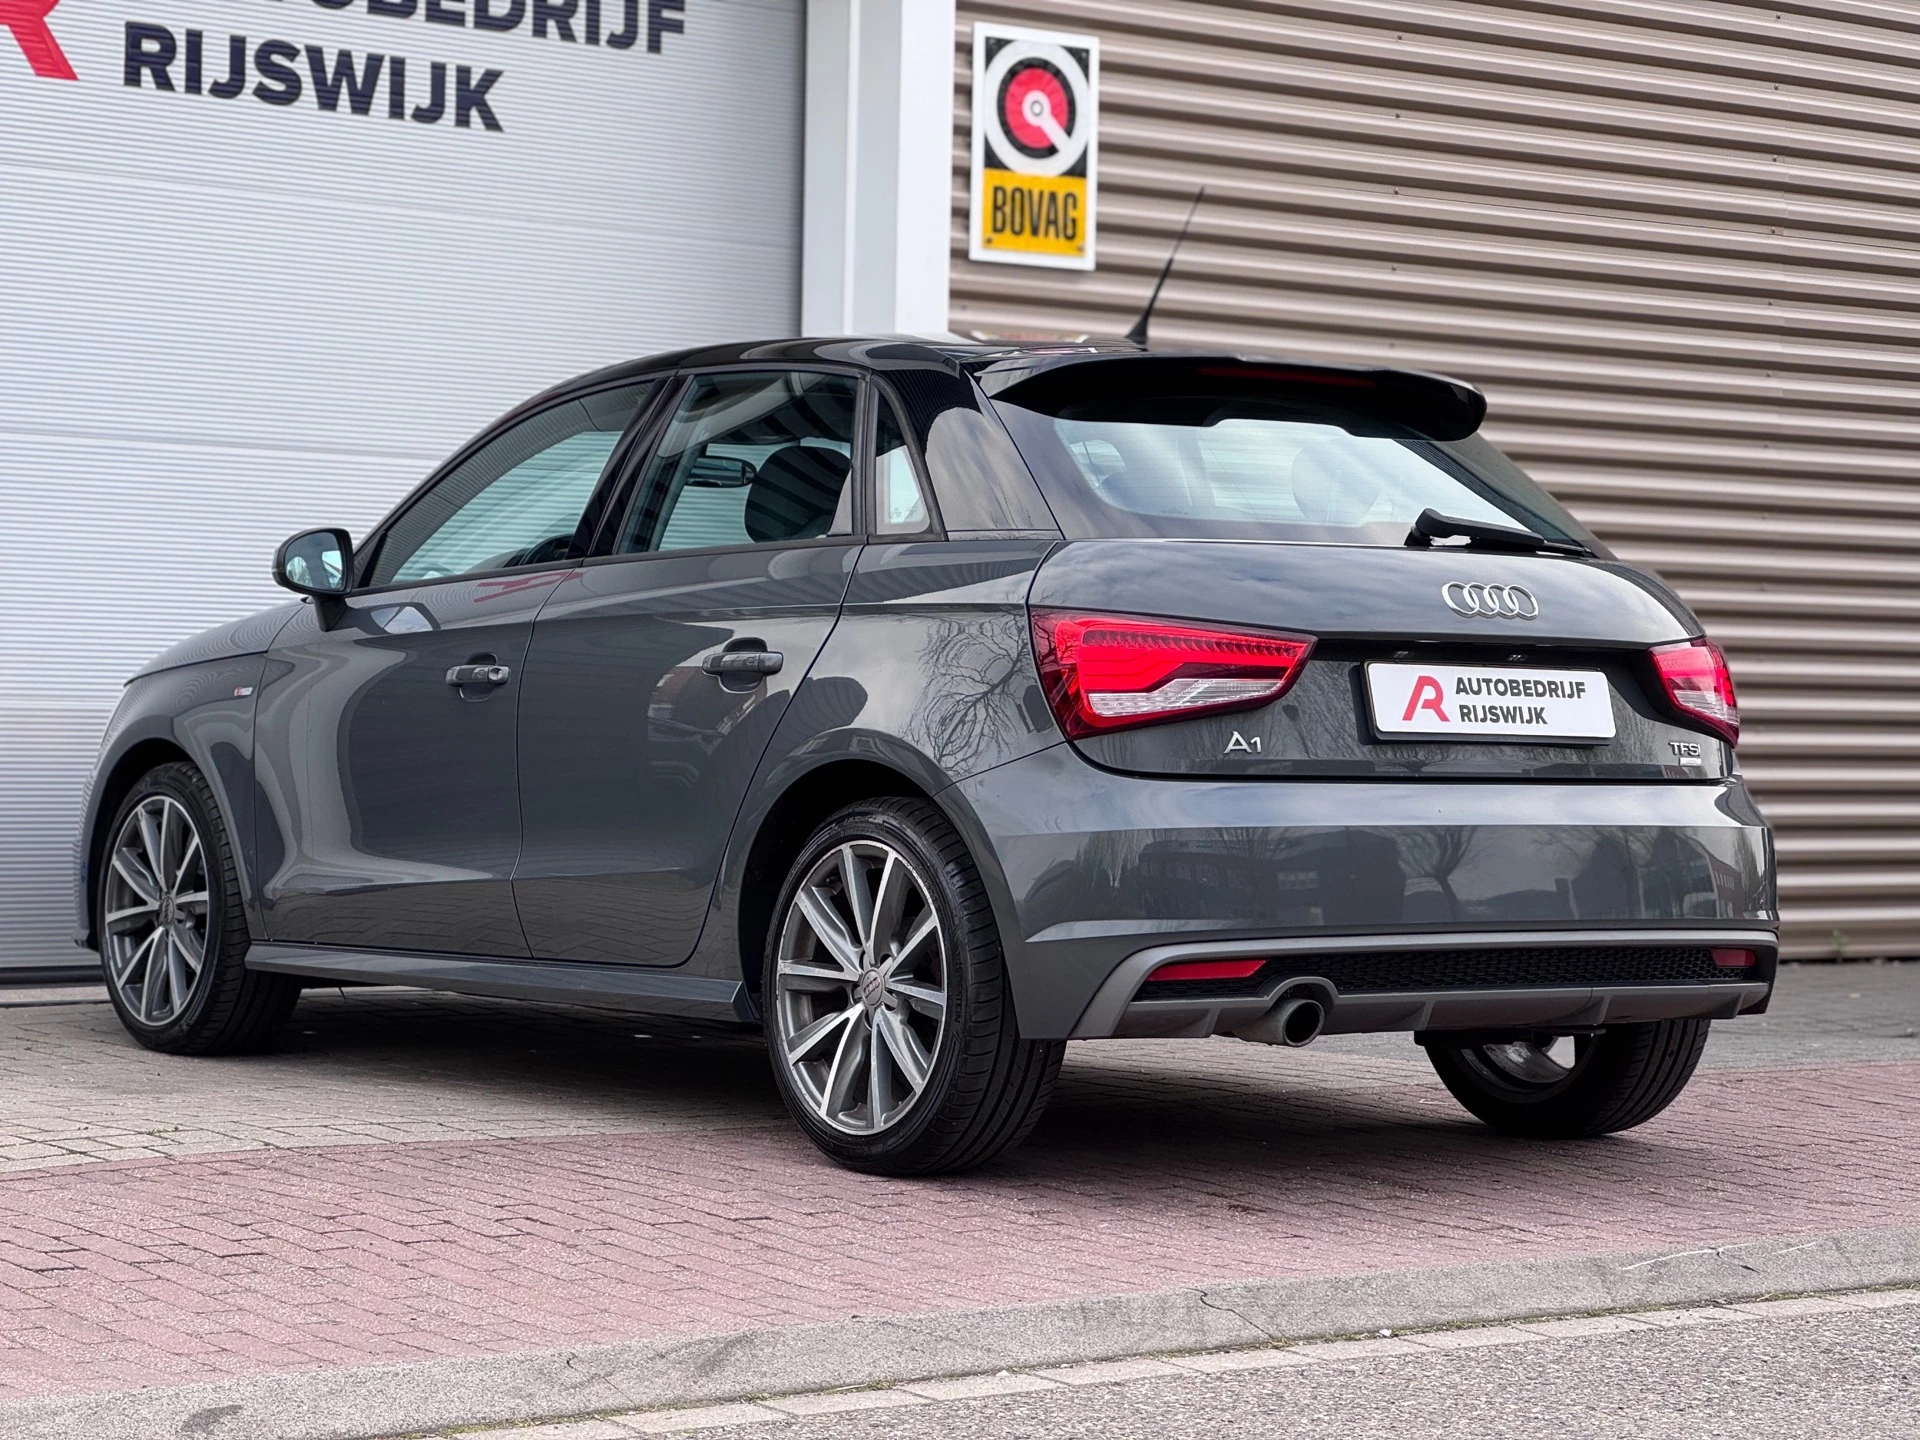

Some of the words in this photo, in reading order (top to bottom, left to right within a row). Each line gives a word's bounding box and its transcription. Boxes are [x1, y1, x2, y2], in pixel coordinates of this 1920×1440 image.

[123, 21, 504, 132] RIJSWIJK
[992, 186, 1078, 241] BOVAG
[1455, 677, 1586, 699] AUTOBEDRIJF
[1458, 704, 1548, 724] RIJSWIJK
[1223, 731, 1262, 754] A1
